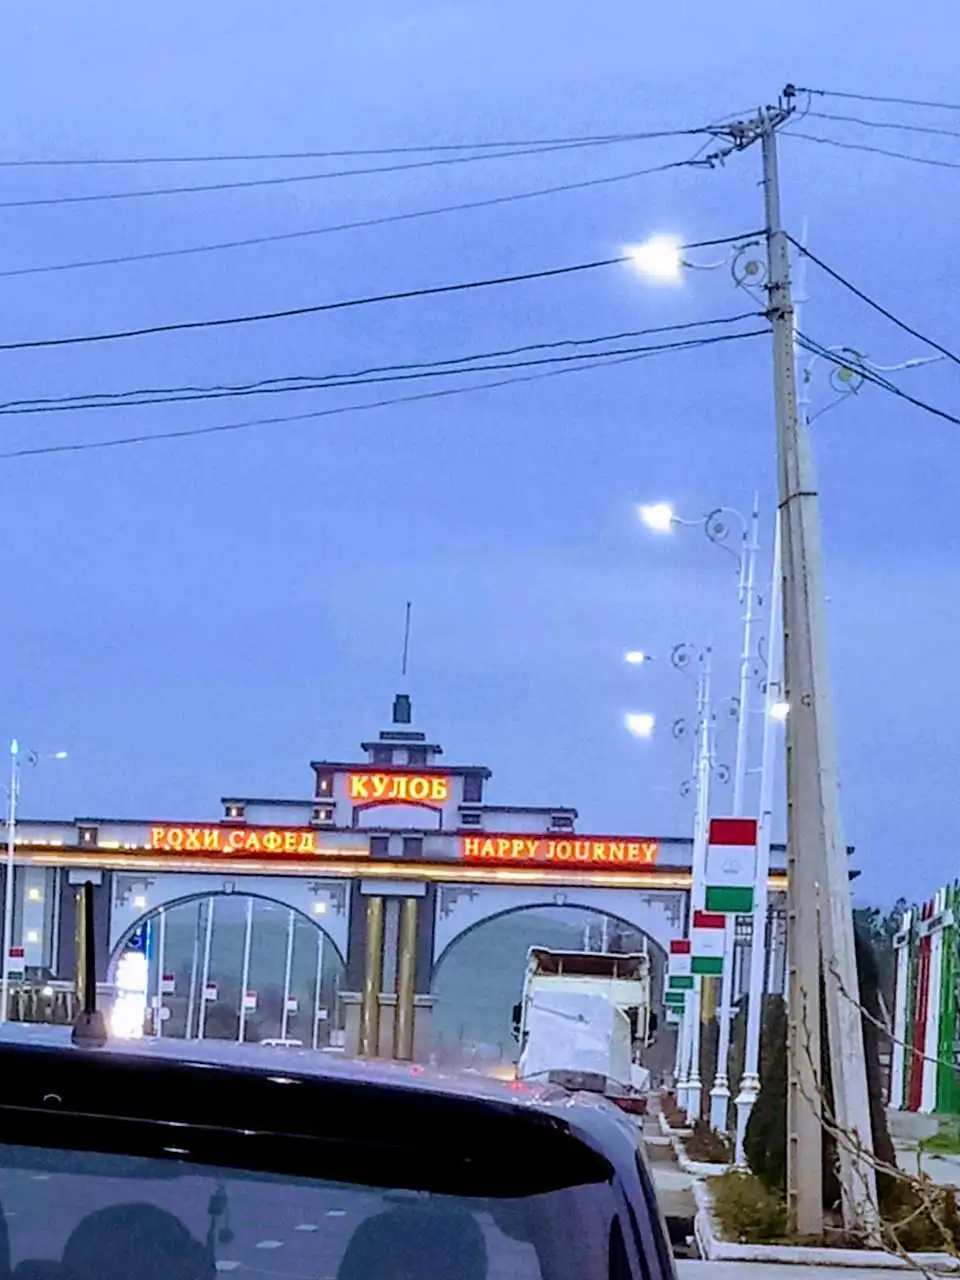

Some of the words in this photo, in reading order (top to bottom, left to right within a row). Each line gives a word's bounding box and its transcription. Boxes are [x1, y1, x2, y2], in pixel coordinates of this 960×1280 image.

[228, 831, 316, 853] САФЕД
[464, 836, 540, 859] HAPPY
[545, 839, 657, 864] JOURNEY
